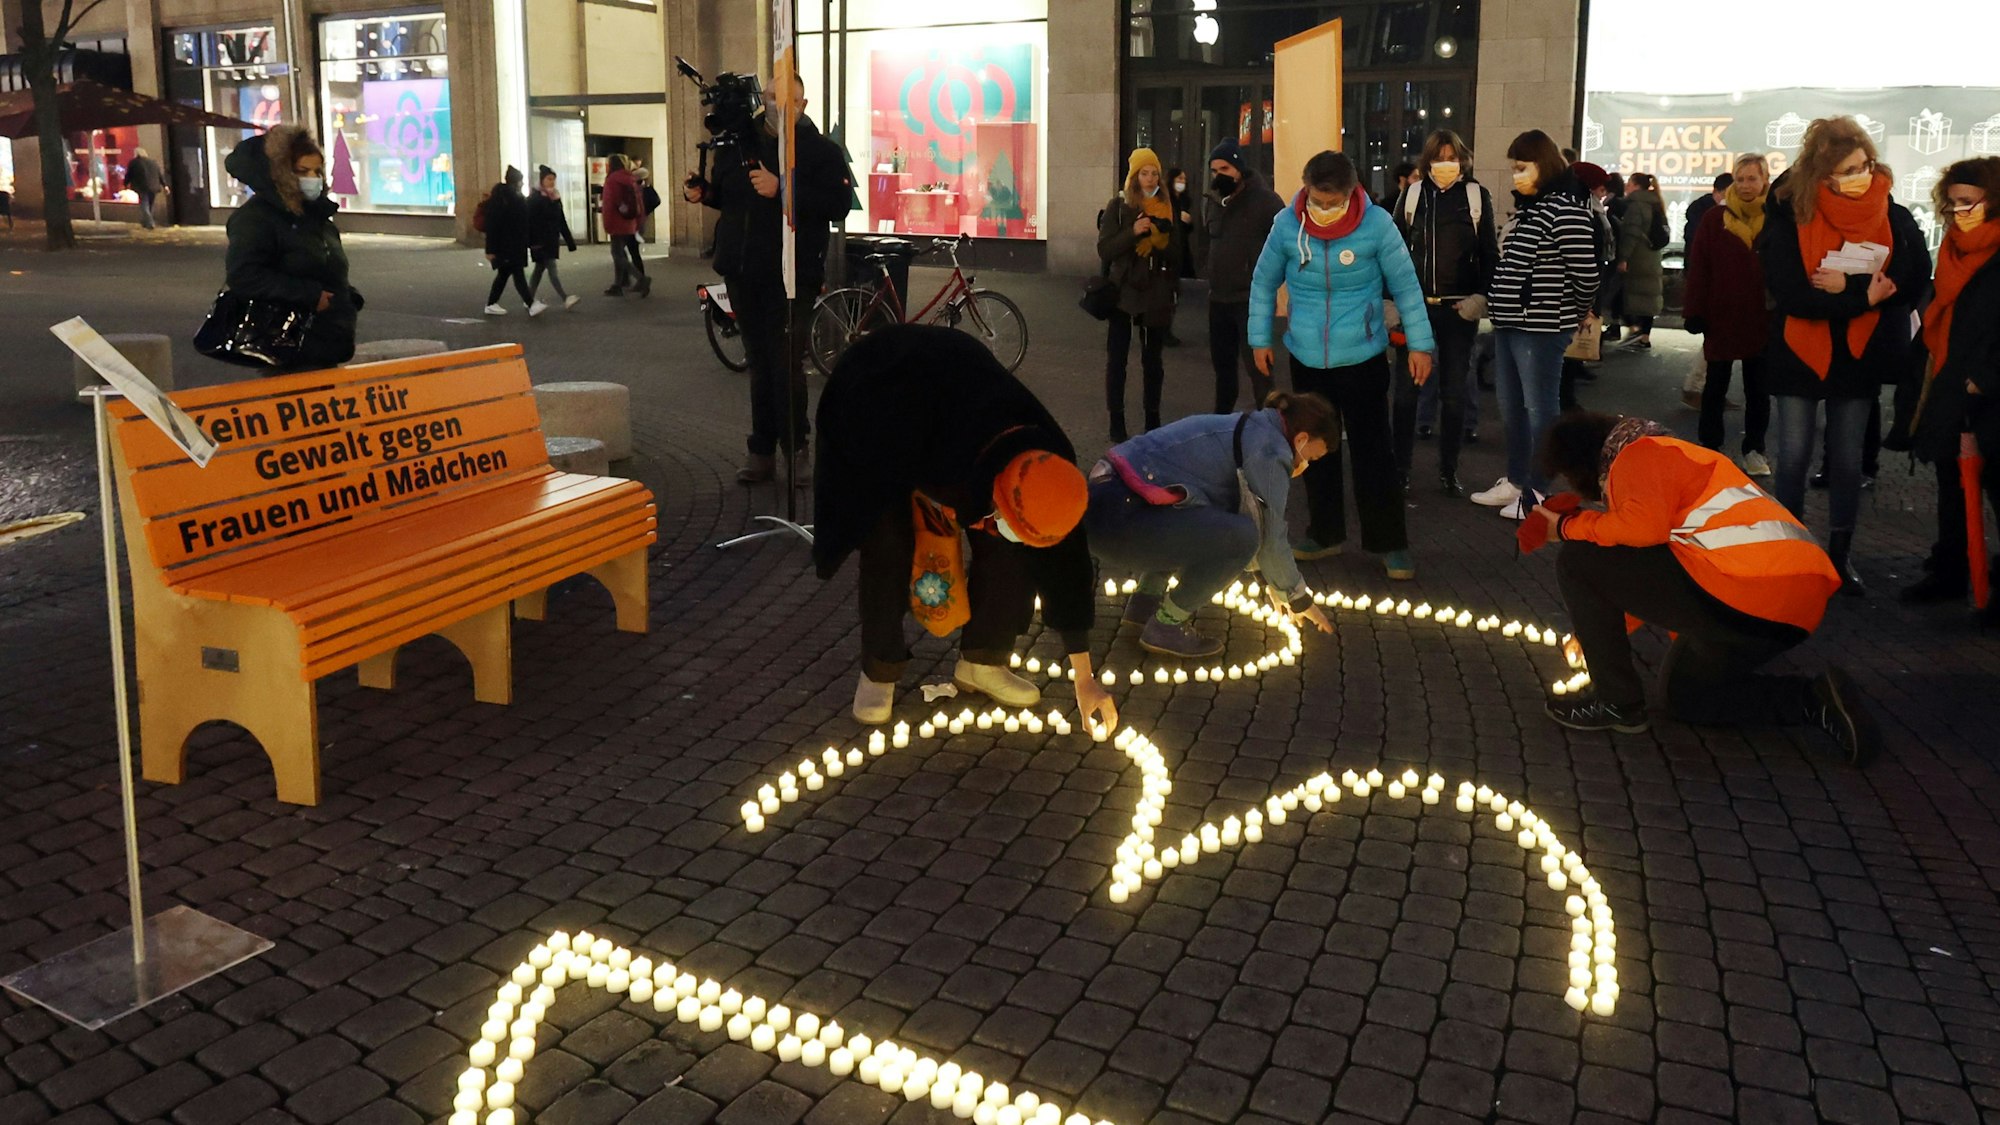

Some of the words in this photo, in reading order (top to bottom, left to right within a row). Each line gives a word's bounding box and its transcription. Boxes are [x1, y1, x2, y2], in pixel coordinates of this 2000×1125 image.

[1619, 152, 1787, 175] SHOPPIG
[1620, 125, 1728, 150] BLACK
[195, 406, 269, 444] ein
[276, 396, 360, 432] Platz
[365, 384, 408, 415] für
[255, 432, 373, 480] Gewalt
[379, 416, 463, 461] gegen
[178, 499, 309, 554] Frauen
[318, 472, 380, 512] und
[385, 449, 508, 497] Mädchen
